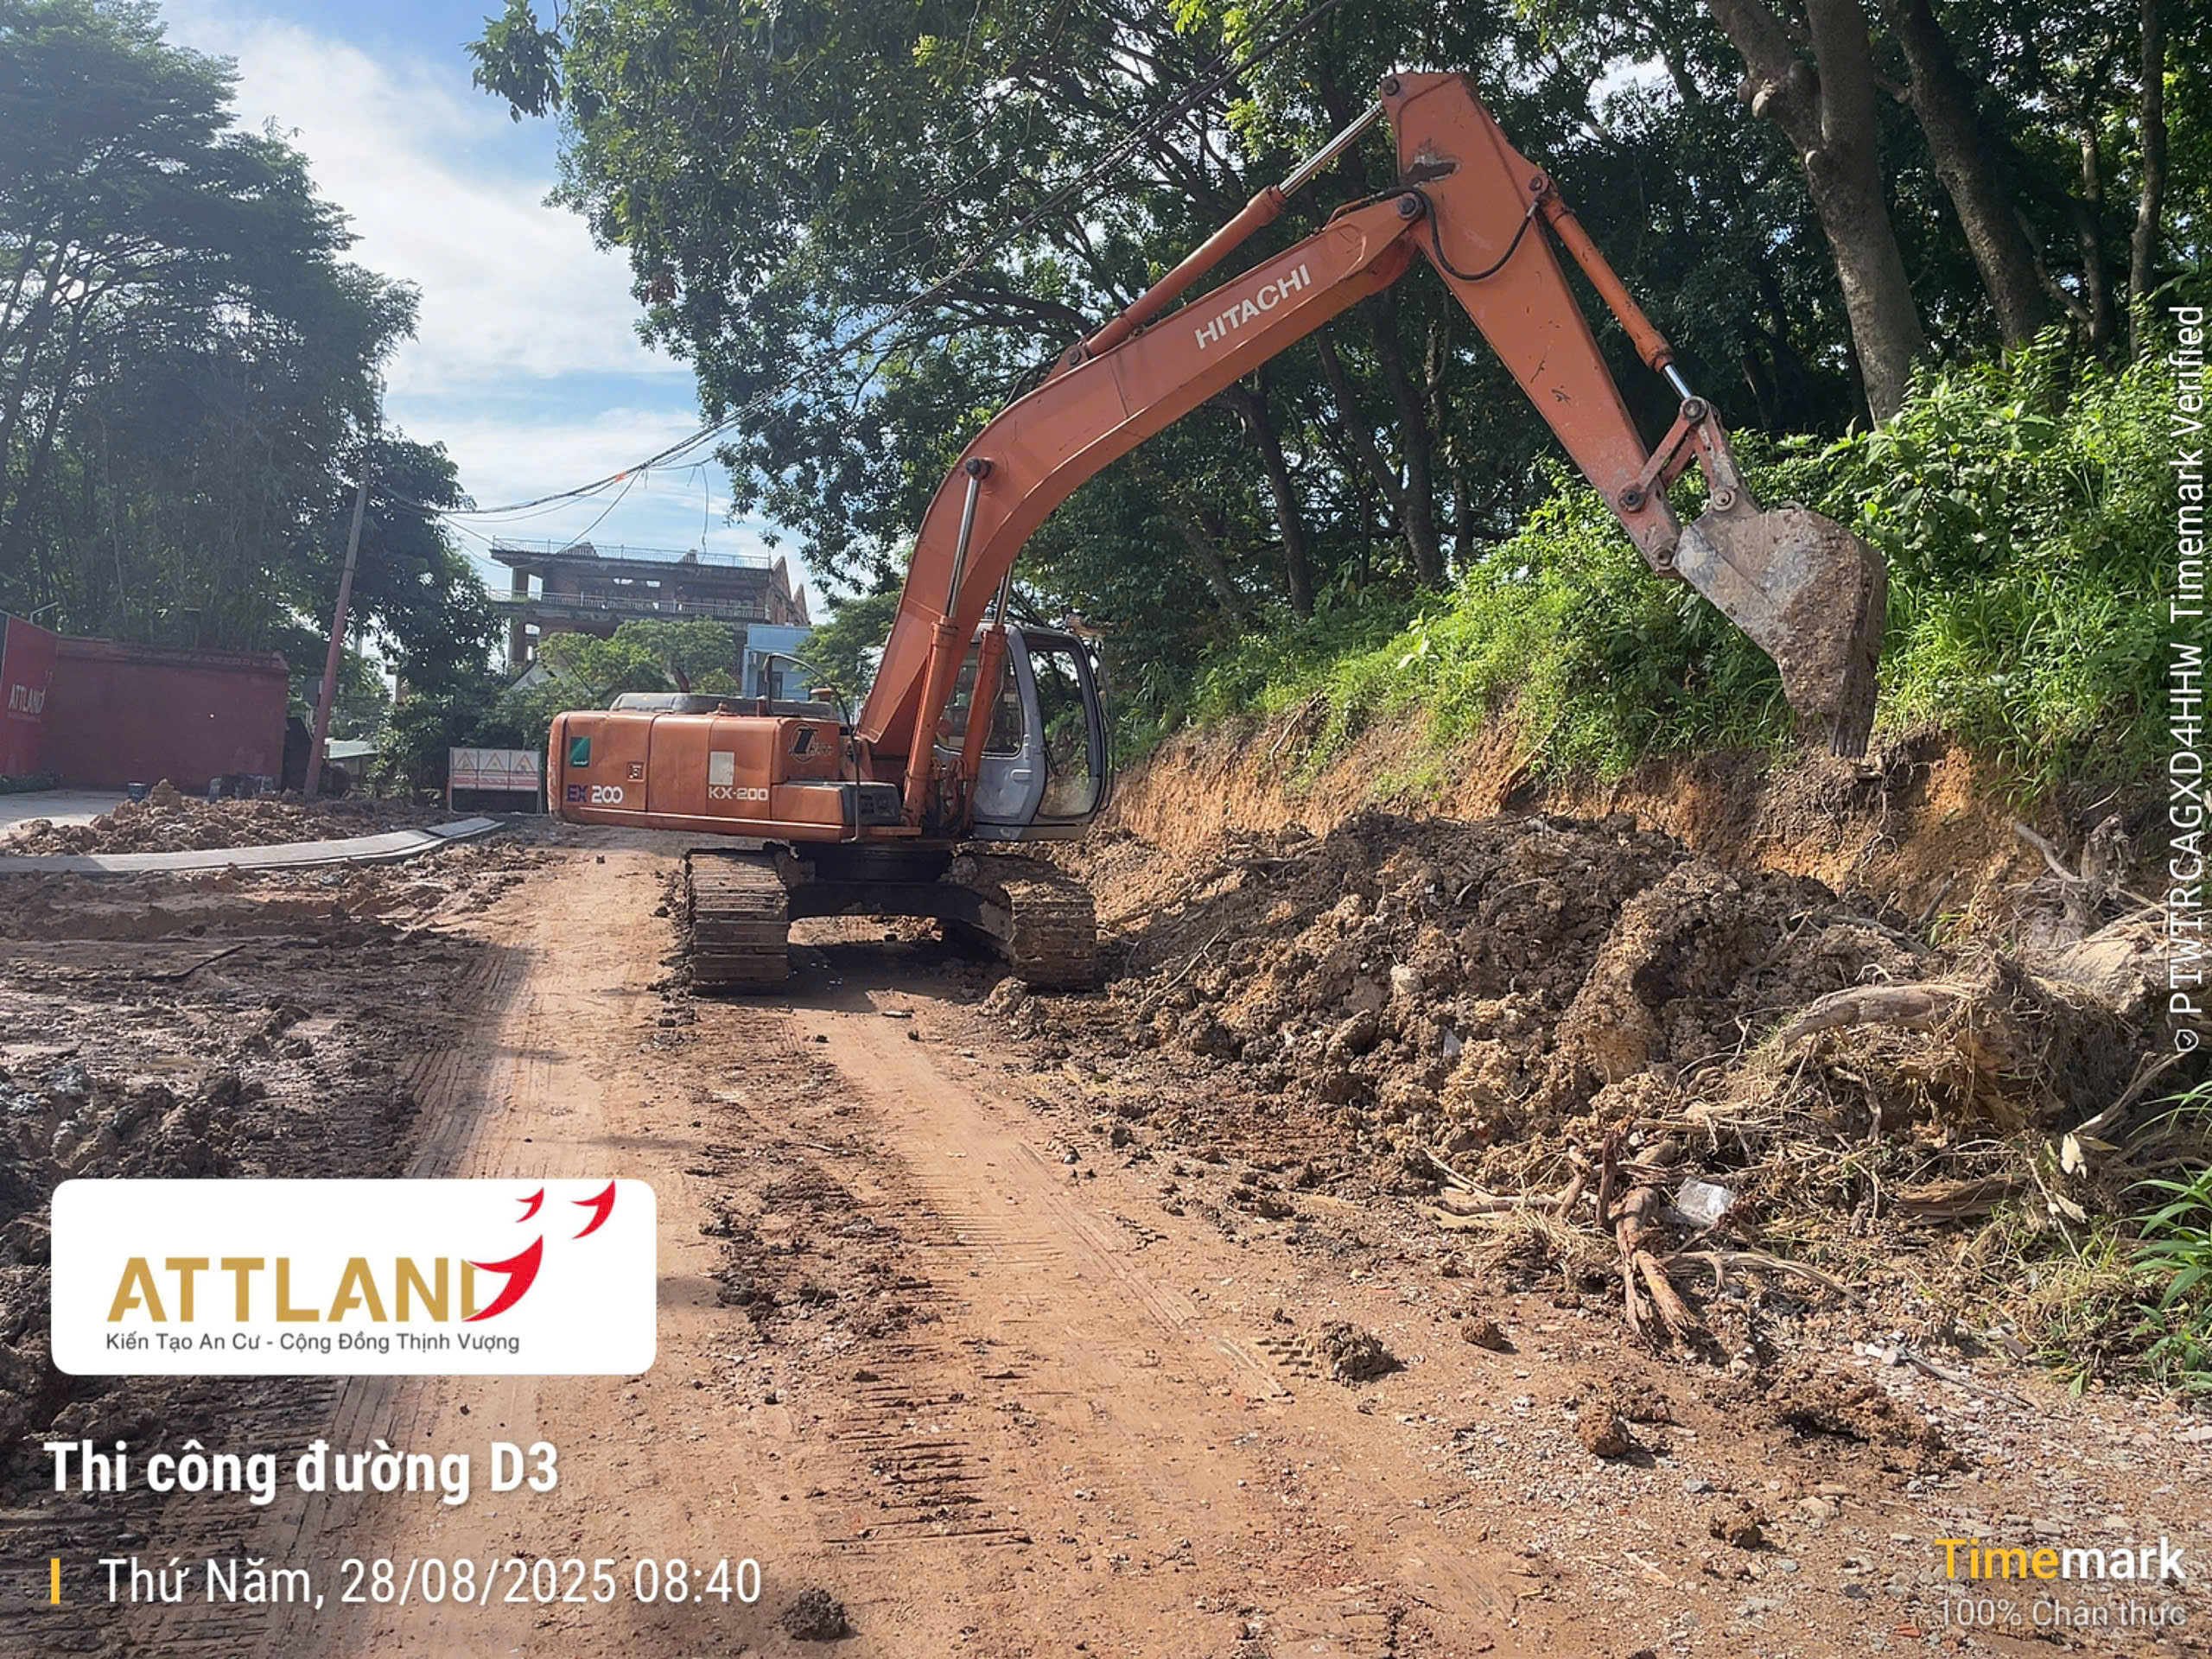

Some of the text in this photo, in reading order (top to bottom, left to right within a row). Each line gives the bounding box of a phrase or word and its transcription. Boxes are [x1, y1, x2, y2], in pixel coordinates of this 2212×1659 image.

[1195, 264, 1311, 349] HITACHI
[8, 683, 47, 714] ATTLAND
[567, 785, 623, 804] EX 200
[709, 786, 768, 801] KX-200
